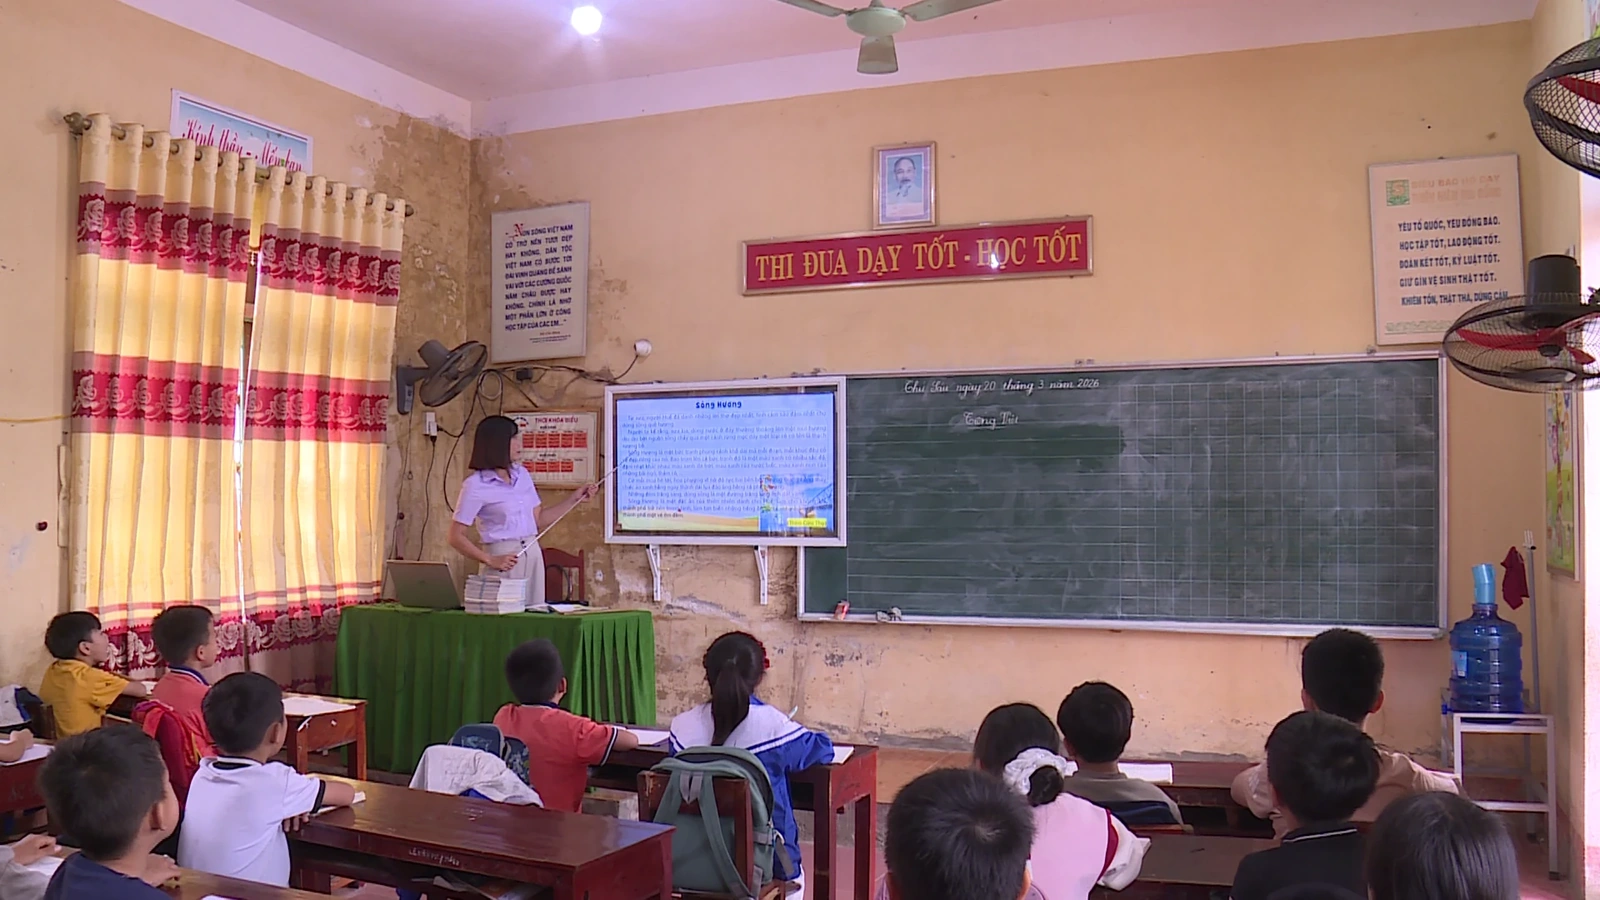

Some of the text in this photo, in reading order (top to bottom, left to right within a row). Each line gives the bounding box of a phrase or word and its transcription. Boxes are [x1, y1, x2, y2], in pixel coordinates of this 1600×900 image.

[756, 253, 793, 281] THI
[802, 250, 848, 277] ĐUA
[857, 245, 902, 276] DẠY
[912, 235, 959, 270] TỐT
[976, 238, 1027, 270] HỌC
[1033, 226, 1082, 263] TỐT
[983, 381, 996, 391] 20
[1003, 378, 1035, 396] tháng
[1038, 380, 1044, 389] 3
[1050, 380, 1074, 389] năm
[1077, 378, 1100, 388] 2026
